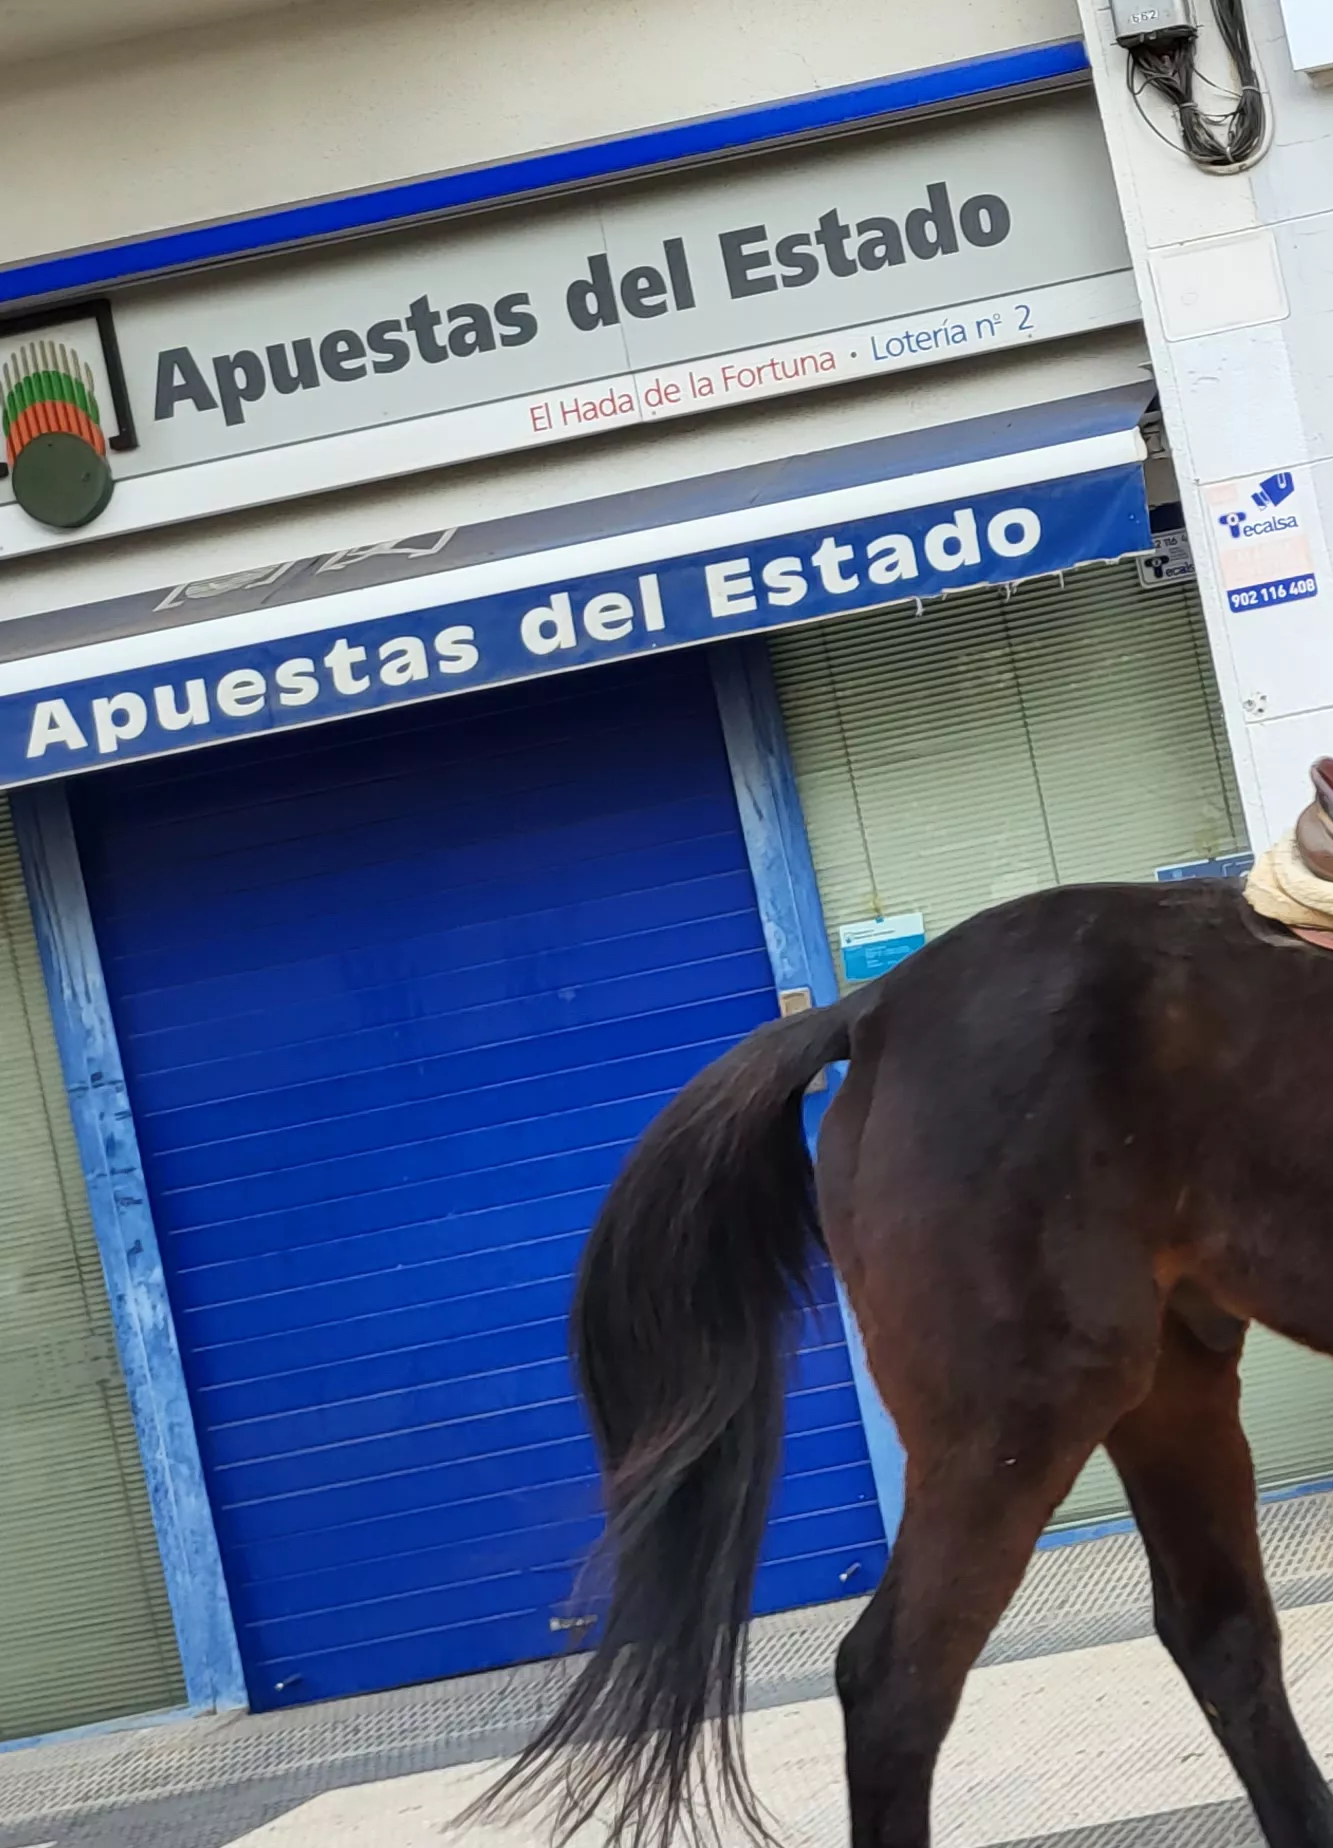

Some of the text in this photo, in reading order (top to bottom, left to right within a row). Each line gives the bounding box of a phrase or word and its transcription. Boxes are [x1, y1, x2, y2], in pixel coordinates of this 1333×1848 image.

[154, 181, 1012, 427] Apuestas del Estado
[530, 403, 553, 433] El
[560, 388, 634, 427] Hada
[644, 378, 681, 409] de
[689, 370, 714, 399] la
[721, 349, 836, 394] Fortuna
[871, 318, 968, 362] Lotería
[1016, 304, 1034, 332] 2
[25, 505, 1042, 760] Apuestas del Estado
[1231, 578, 1316, 608] 902 116 408
